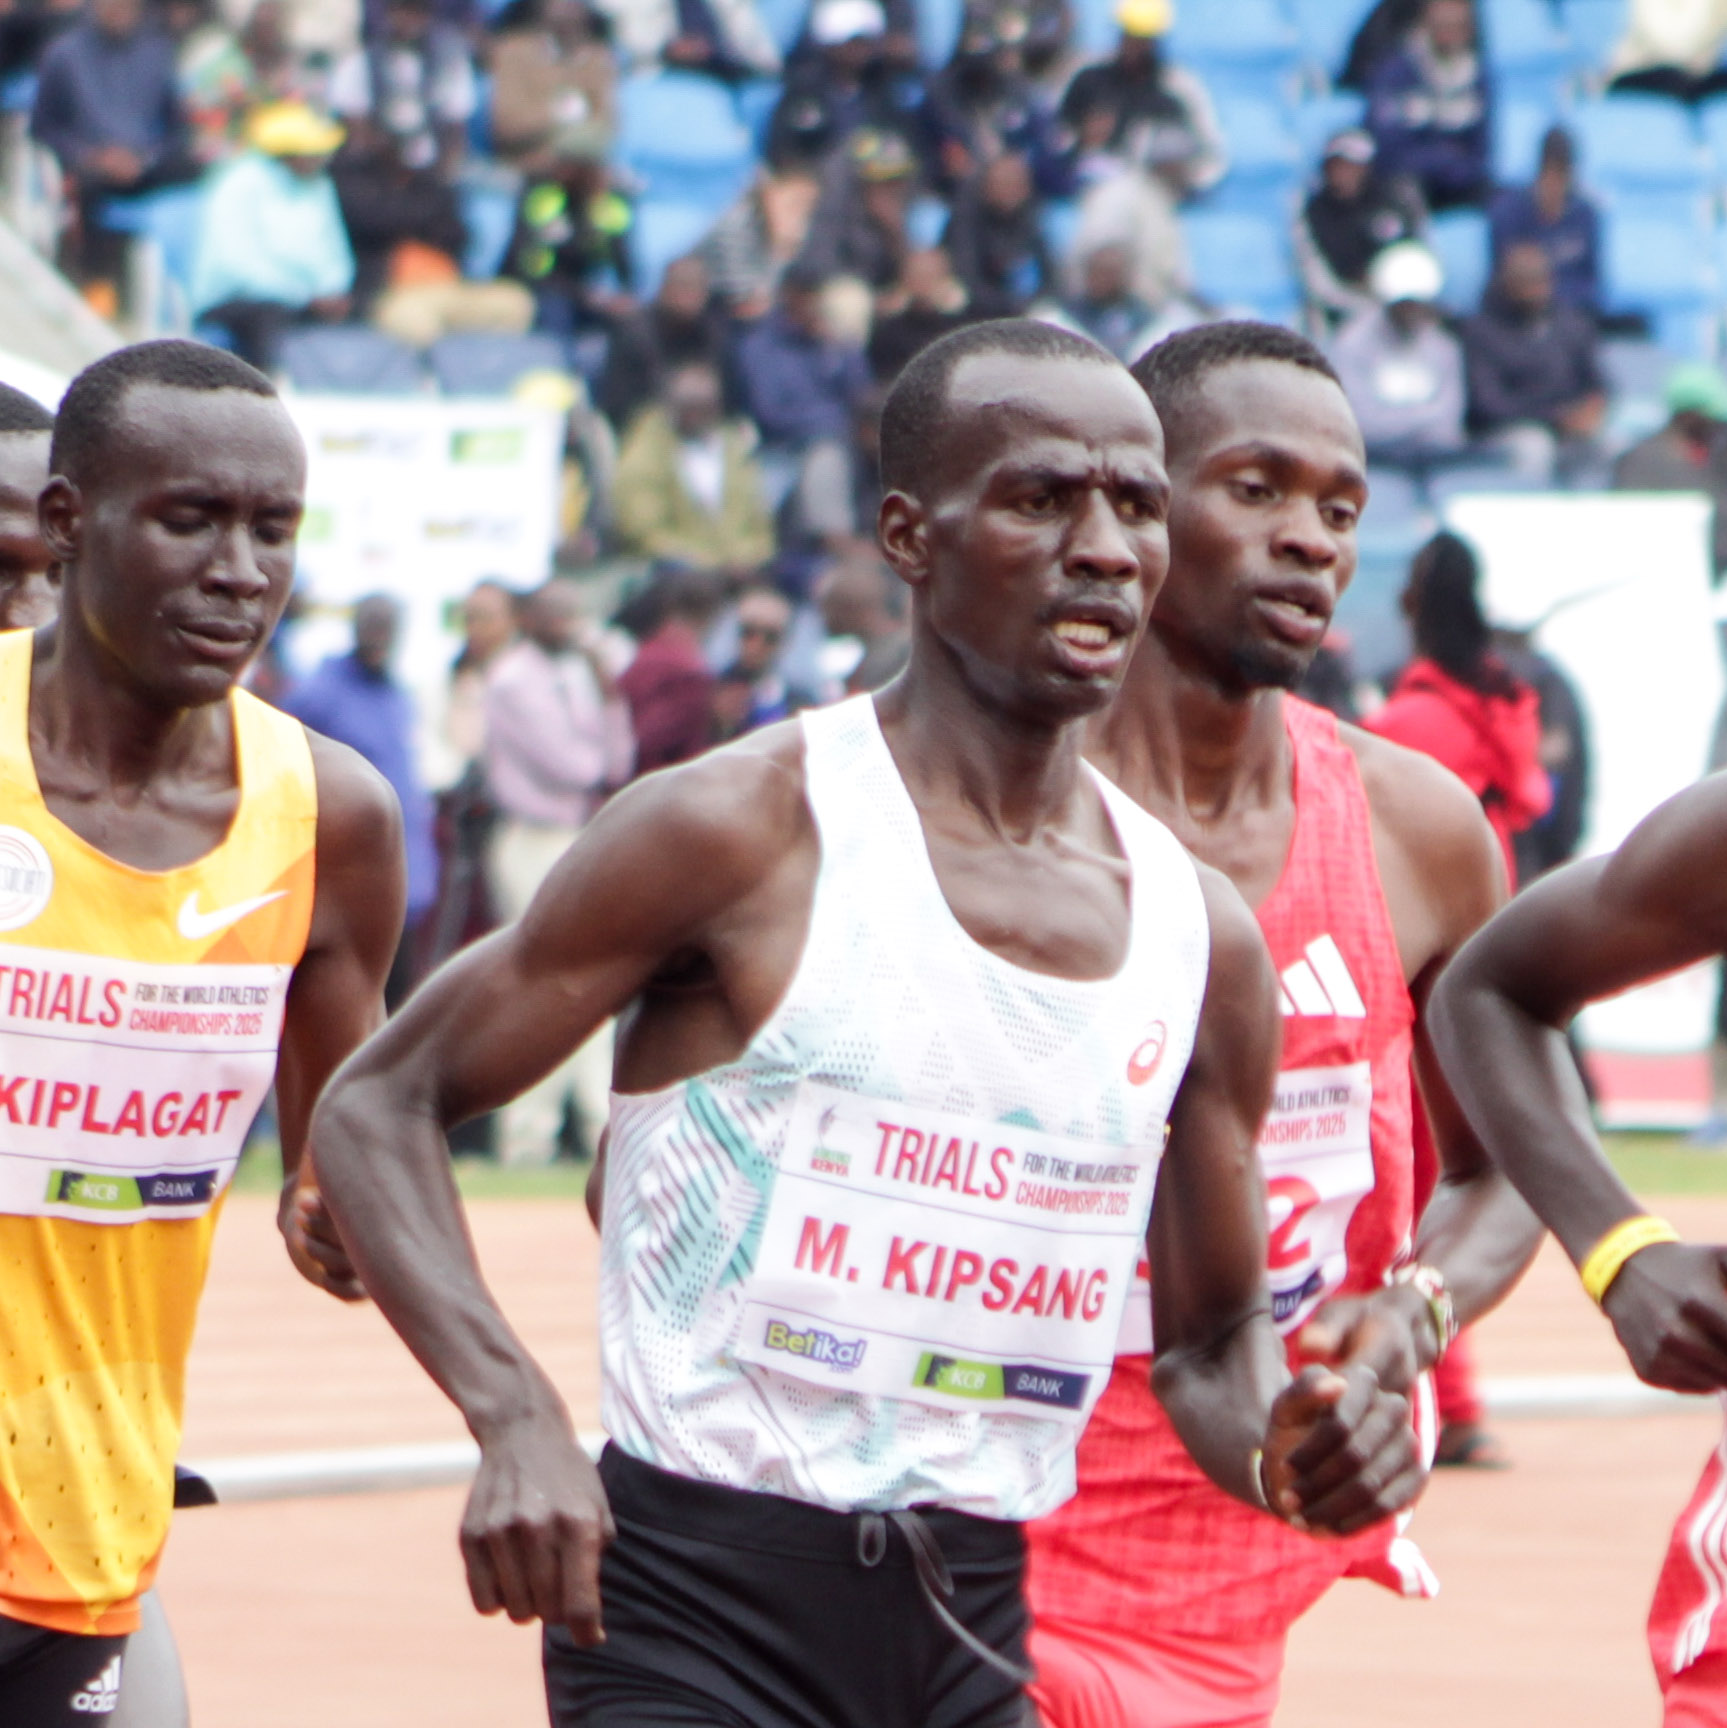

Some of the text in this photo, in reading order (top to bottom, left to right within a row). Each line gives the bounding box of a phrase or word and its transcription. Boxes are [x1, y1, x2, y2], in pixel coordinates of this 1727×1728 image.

[135, 983, 270, 1005] FOR THE WORLD ATHLETICS
[129, 1008, 233, 1036] CHAMPIONSHIPS
[874, 1120, 1014, 1201] TRIALS
[1023, 1151, 1048, 1174] FOR
[1049, 1157, 1073, 1180] THE
[81, 1180, 196, 1201] KCB BANK
[794, 1215, 1108, 1322] M. KIPSANG
[763, 1318, 868, 1368] Betika!
[950, 1368, 1064, 1398] KCB BANK
